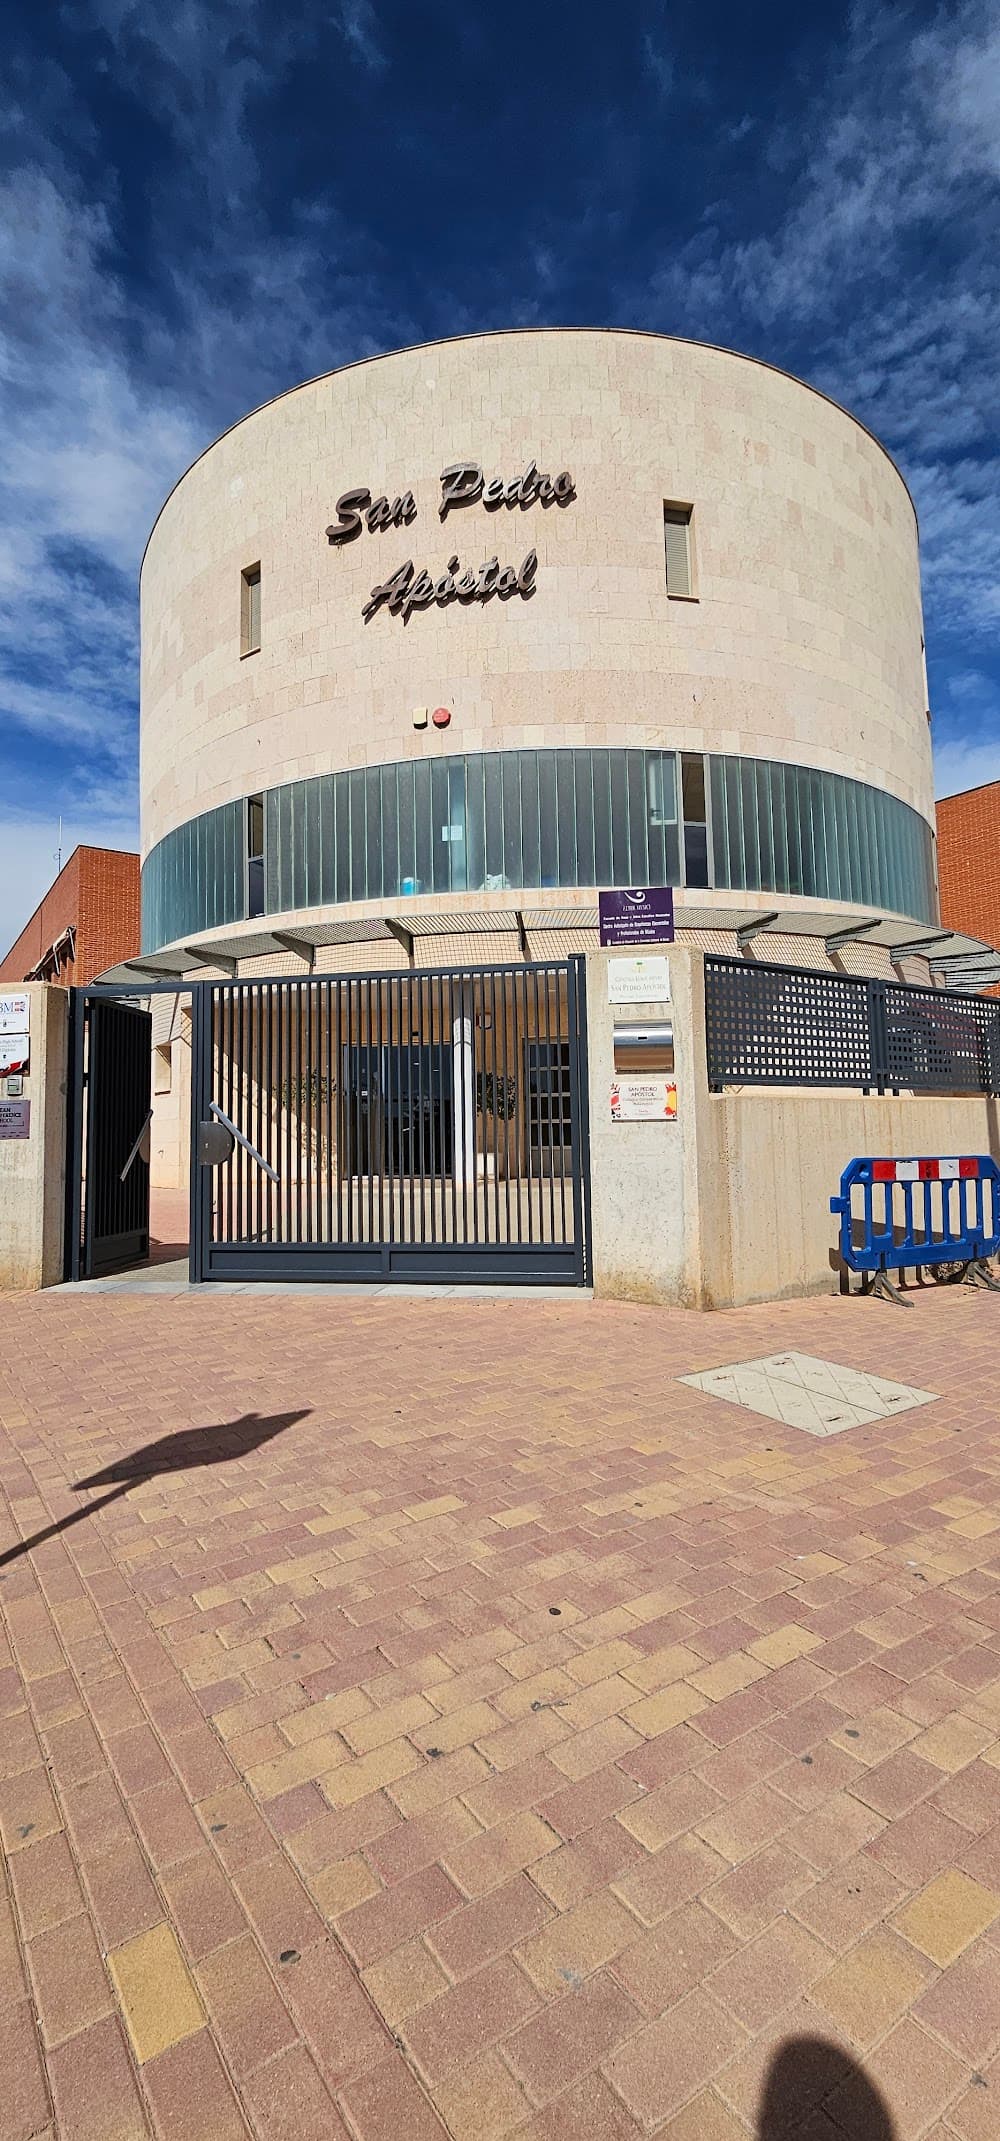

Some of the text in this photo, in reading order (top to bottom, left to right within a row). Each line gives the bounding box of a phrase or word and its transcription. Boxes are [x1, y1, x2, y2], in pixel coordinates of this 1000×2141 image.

[325, 459, 576, 540] San Pedro
[361, 548, 537, 622] Apóstol
